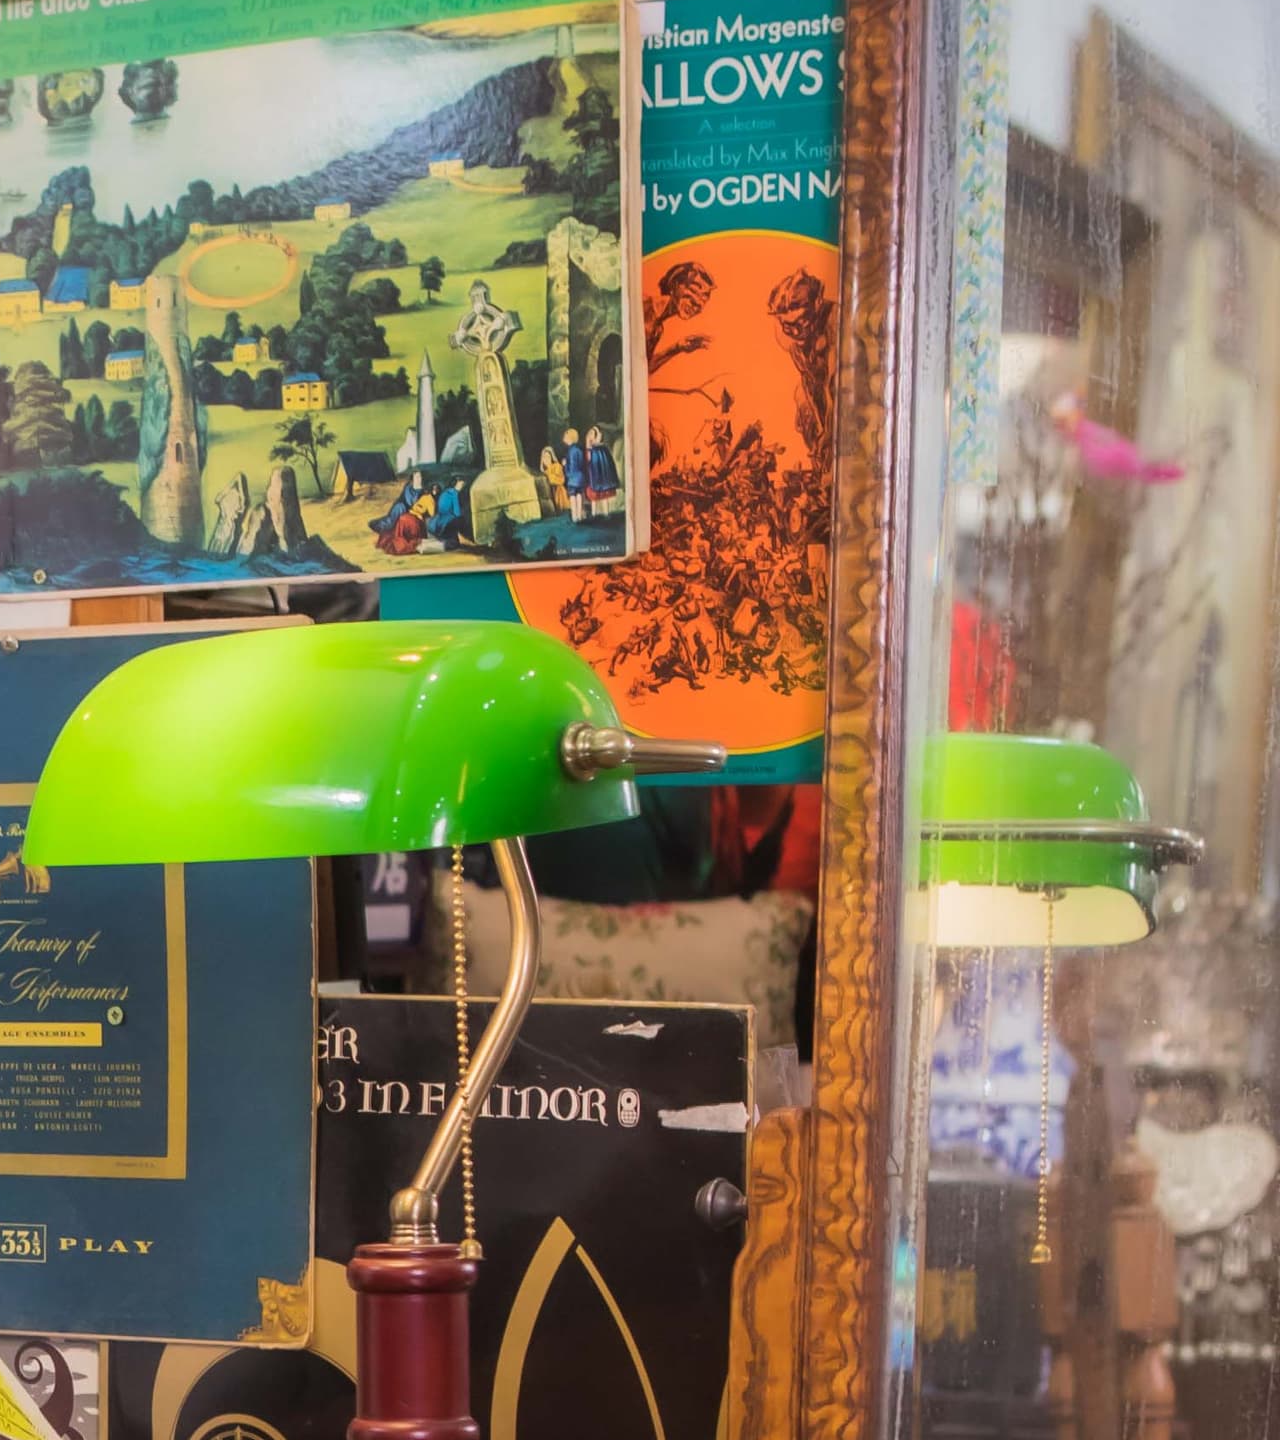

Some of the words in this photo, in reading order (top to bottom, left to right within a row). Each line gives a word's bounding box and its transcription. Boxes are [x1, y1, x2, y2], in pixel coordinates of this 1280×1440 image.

[698, 119, 713, 135] A
[720, 115, 777, 133] selection
[720, 143, 742, 168] by
[747, 141, 788, 162] Max
[652, 183, 682, 215] by
[689, 171, 801, 209] OGDEN
[75, 930, 102, 965] of
[2, 1030, 21, 1038] AGE
[25, 1029, 87, 1038] ENSEMBLES
[326, 1079, 346, 1113] 3
[357, 1078, 411, 1115] IN
[58, 1236, 155, 1254] PLAY
